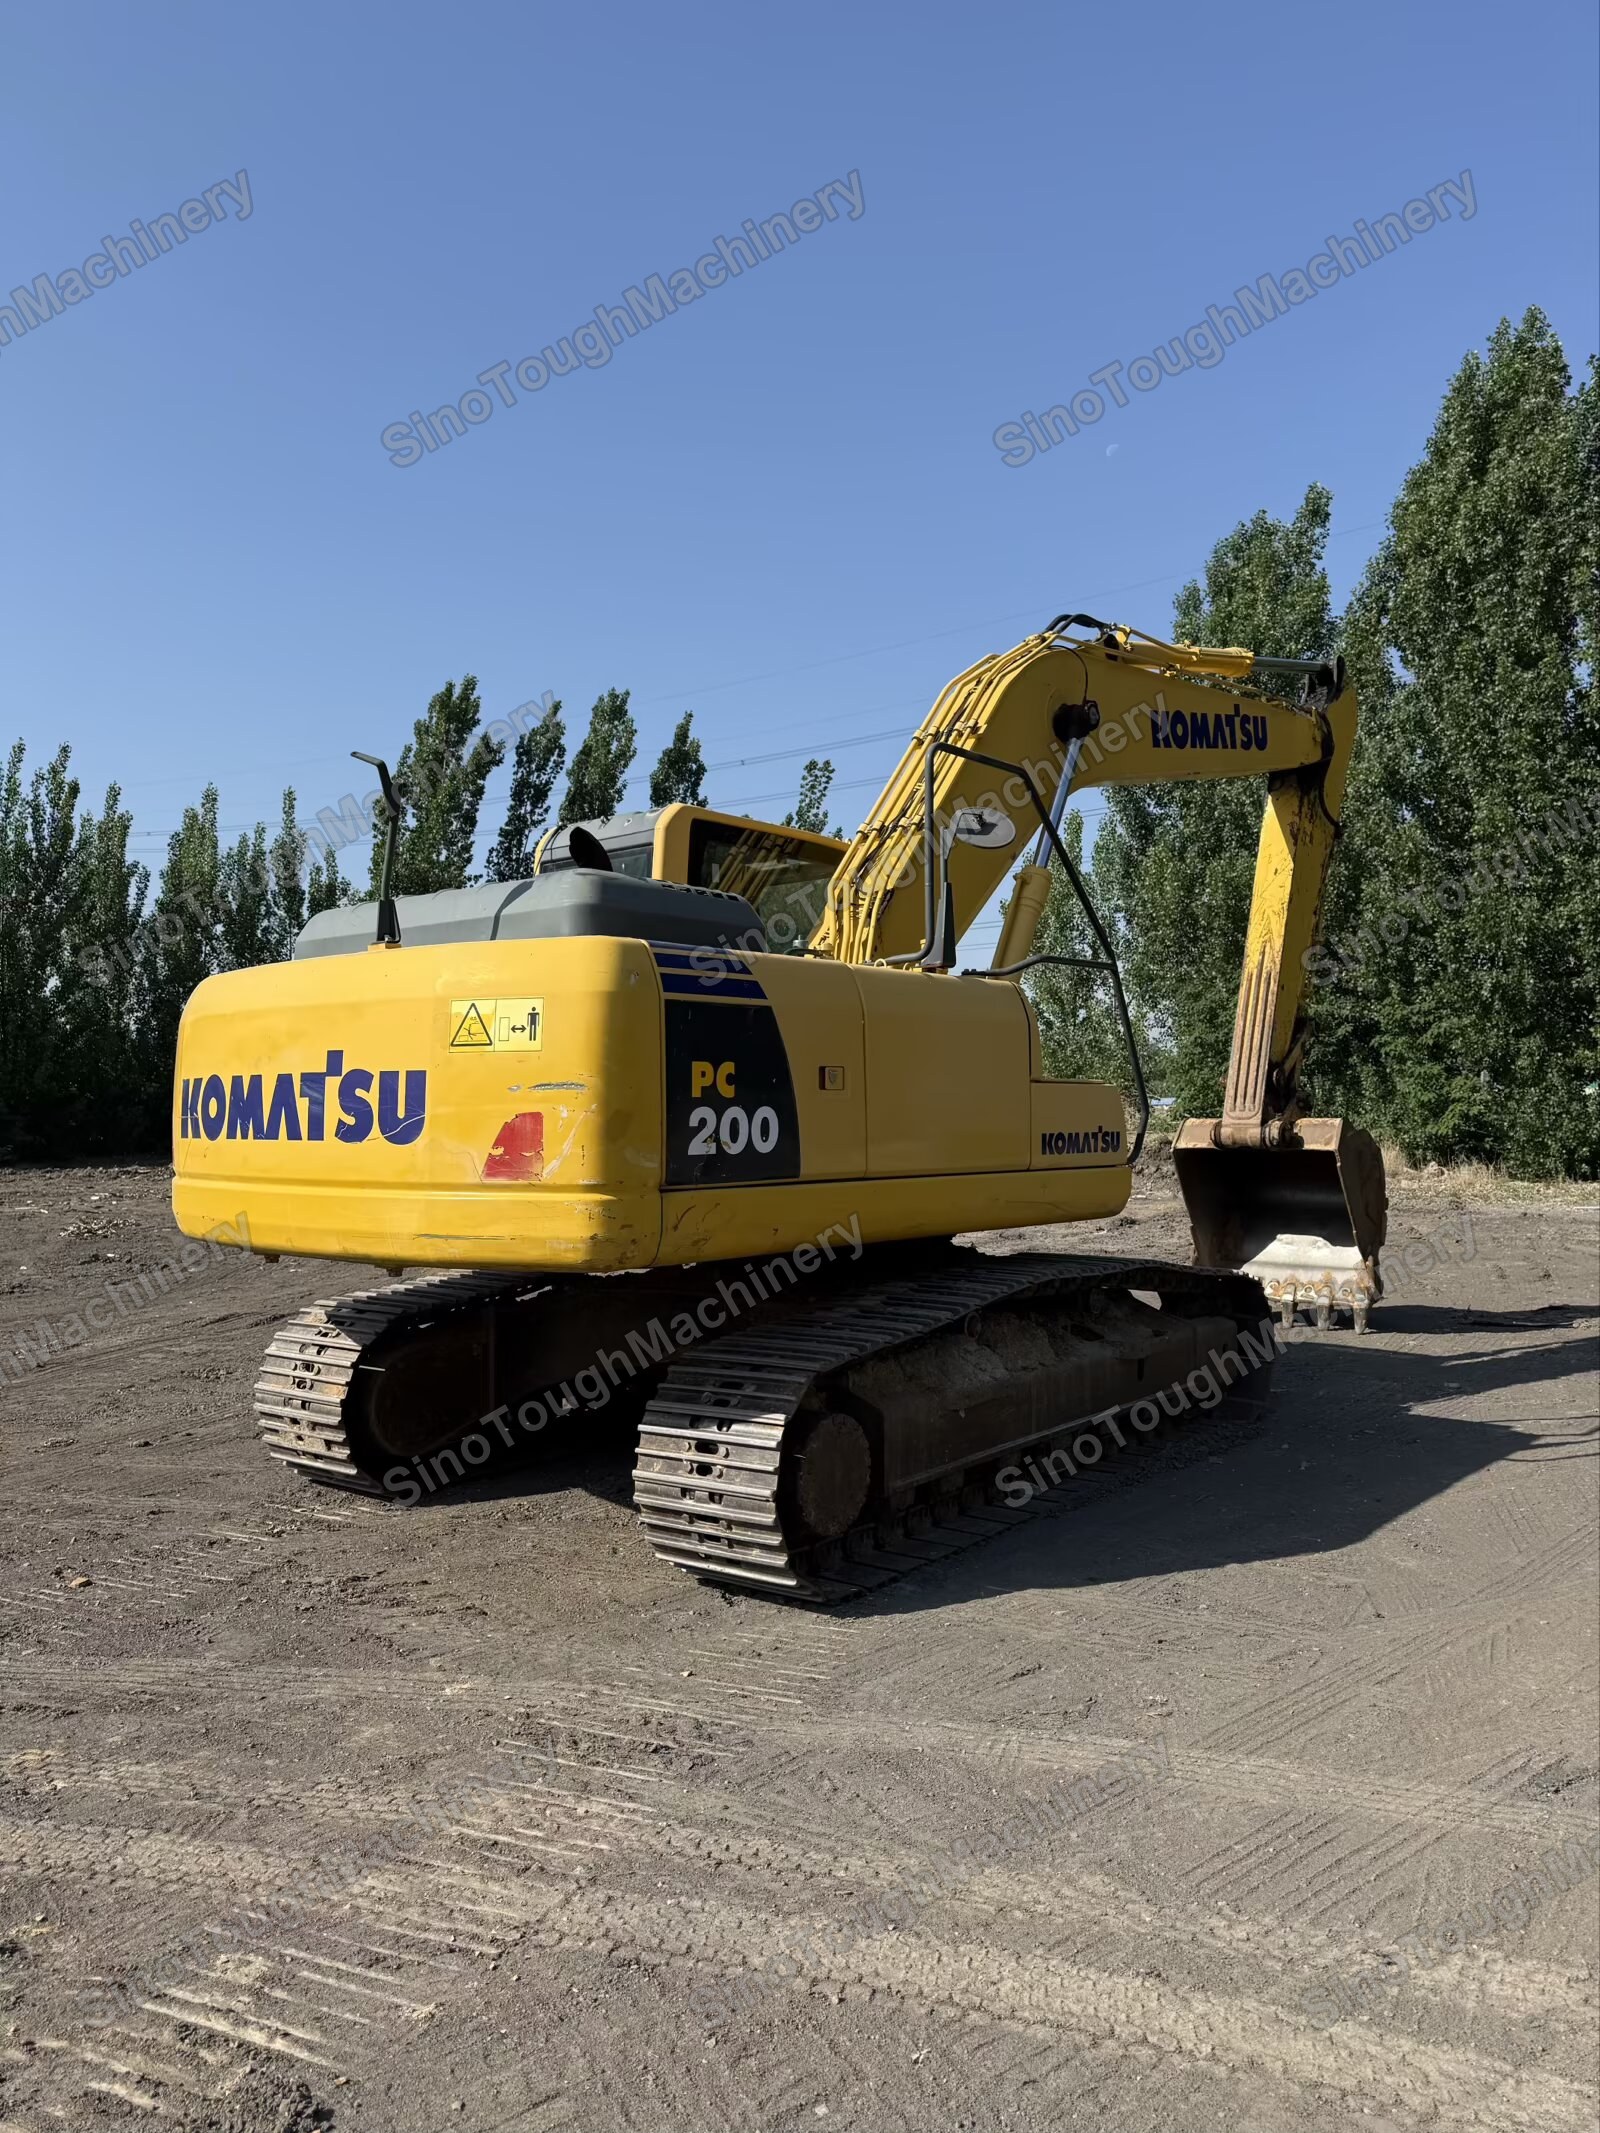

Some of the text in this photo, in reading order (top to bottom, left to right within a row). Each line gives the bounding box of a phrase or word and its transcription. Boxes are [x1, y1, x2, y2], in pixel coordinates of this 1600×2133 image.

[1150, 703, 1268, 752] KOMATSU
[180, 1050, 427, 1146] KOMATSU
[691, 1061, 736, 1099] PC
[687, 1105, 780, 1156] 200
[1041, 1125, 1121, 1156] KOMATSU
